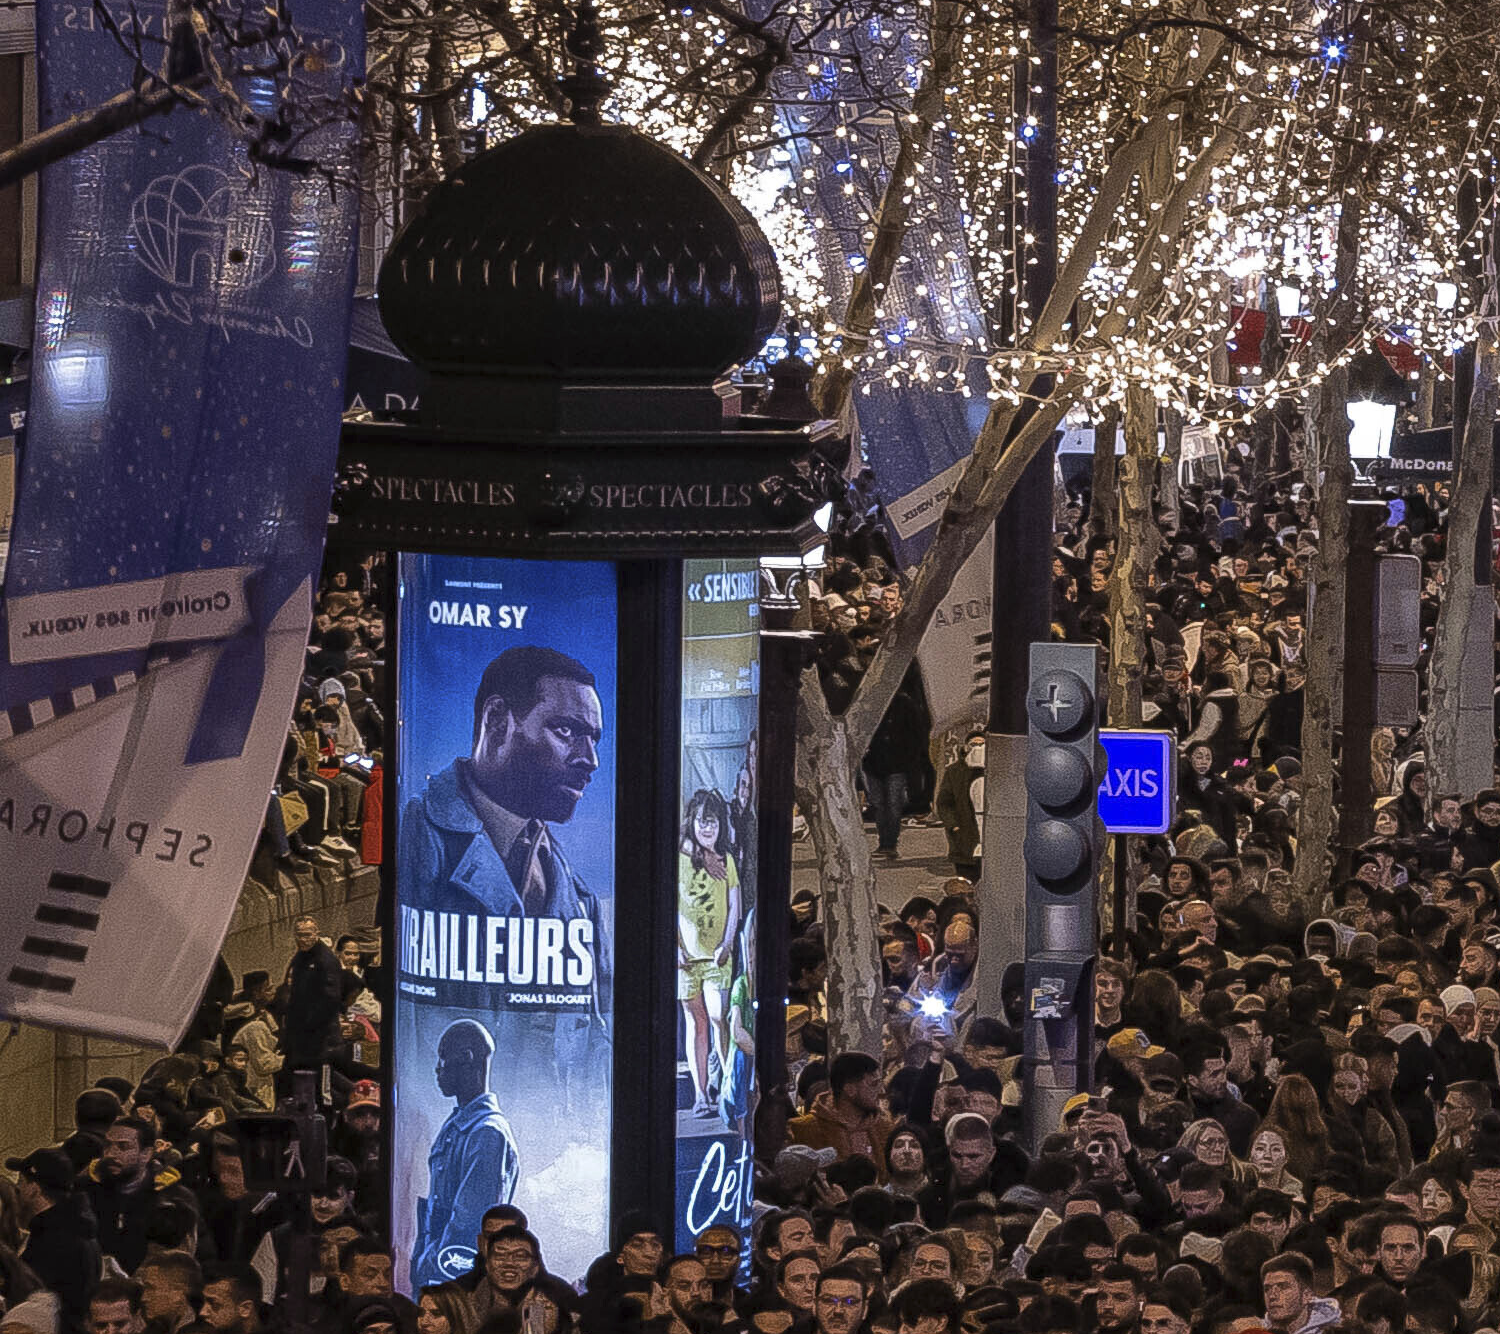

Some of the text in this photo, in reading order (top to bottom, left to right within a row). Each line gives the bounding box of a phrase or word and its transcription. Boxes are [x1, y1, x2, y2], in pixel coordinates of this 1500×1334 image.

[371, 475, 516, 507] SPECTACLES
[589, 483, 752, 508] SPECTACLES
[429, 600, 528, 629] OMAR SY
[1098, 768, 1159, 798] AXIS
[508, 991, 544, 1004] JONAS
